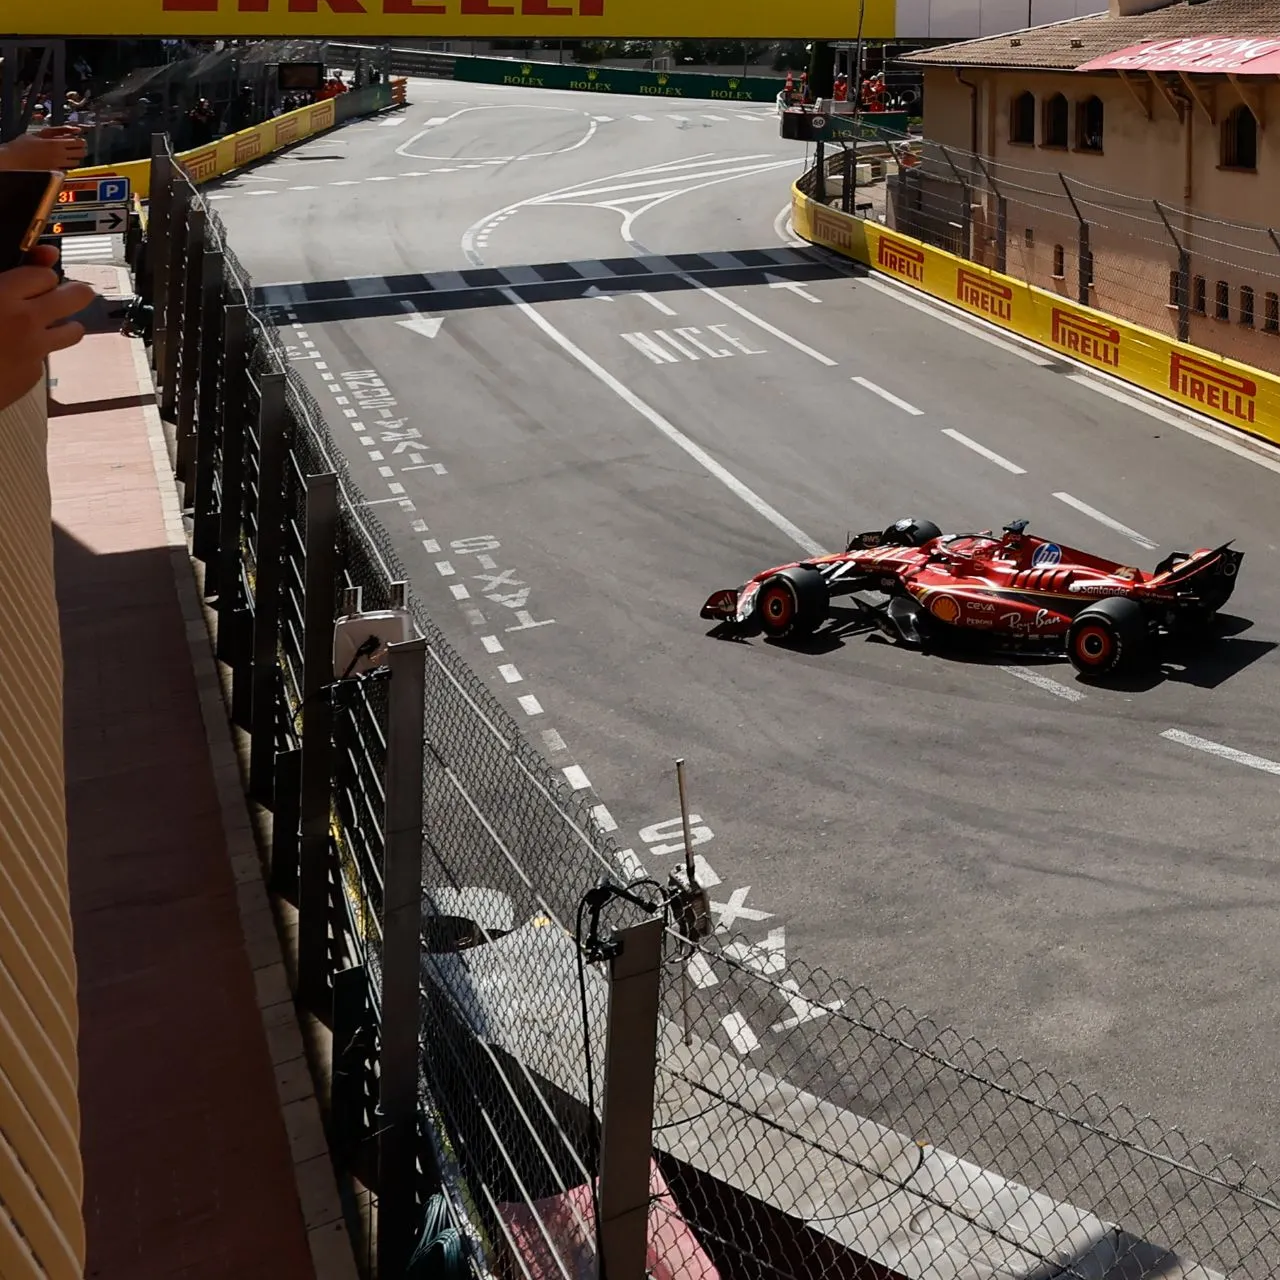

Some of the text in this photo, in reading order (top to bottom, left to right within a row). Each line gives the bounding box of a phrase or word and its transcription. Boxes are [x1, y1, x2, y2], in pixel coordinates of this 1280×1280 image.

[504, 75, 545, 87] ROLEX
[570, 81, 612, 91] ROLEX
[639, 85, 682, 97] ROLEX
[711, 89, 753, 100] ROLEX
[813, 208, 854, 250] PIRELLI
[878, 235, 925, 284] PIRELLI
[957, 267, 1012, 321] PIRELLI
[618, 323, 769, 365] NICE
[1051, 307, 1121, 368] PIRELLI
[1170, 351, 1258, 423] PIRELLI
[1081, 585, 1130, 597] Santander
[1000, 608, 1061, 632] Ray-Ban
